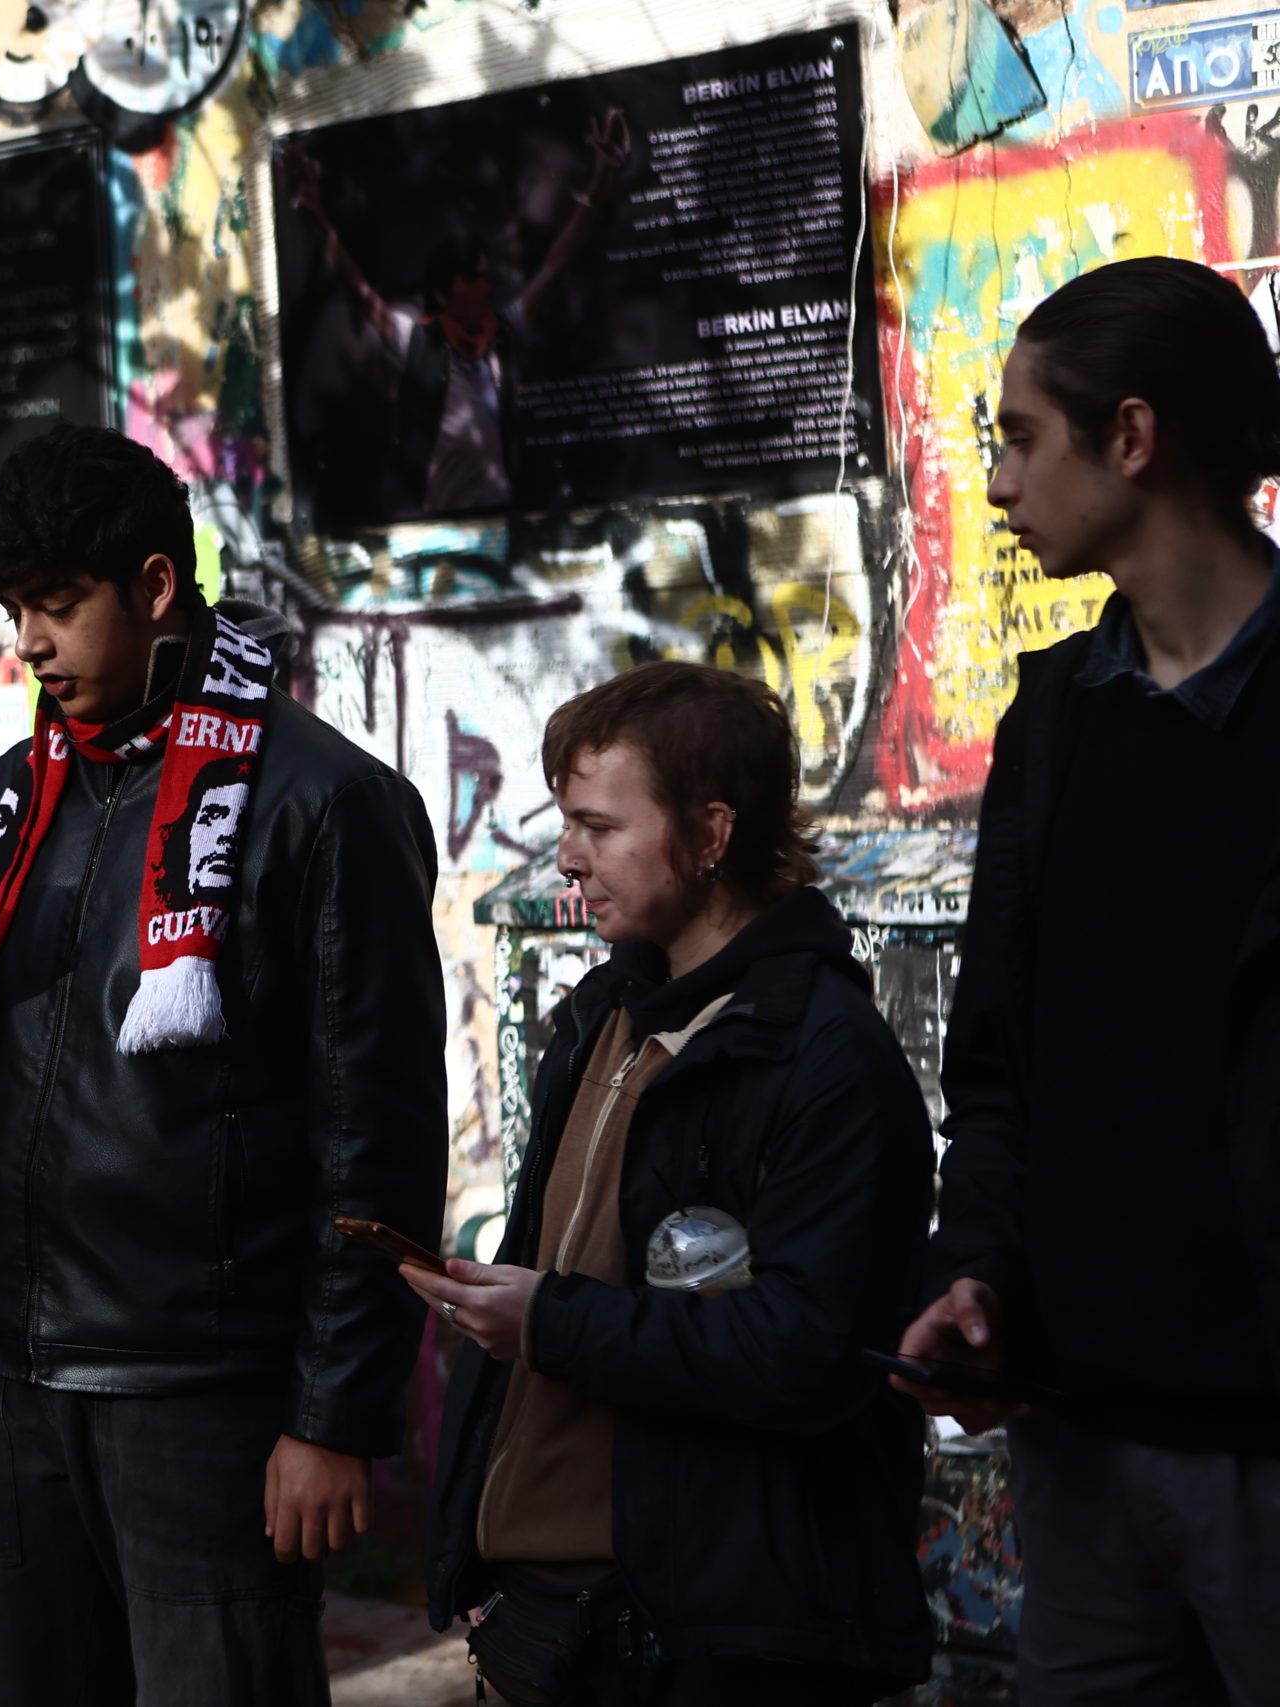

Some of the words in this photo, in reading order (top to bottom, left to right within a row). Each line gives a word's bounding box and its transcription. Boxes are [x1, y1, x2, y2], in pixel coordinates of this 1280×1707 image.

[766, 56, 835, 90] ELVAN
[815, 100, 838, 114] 2013
[696, 304, 775, 338] BERKİN
[780, 298, 849, 328] ELVAN
